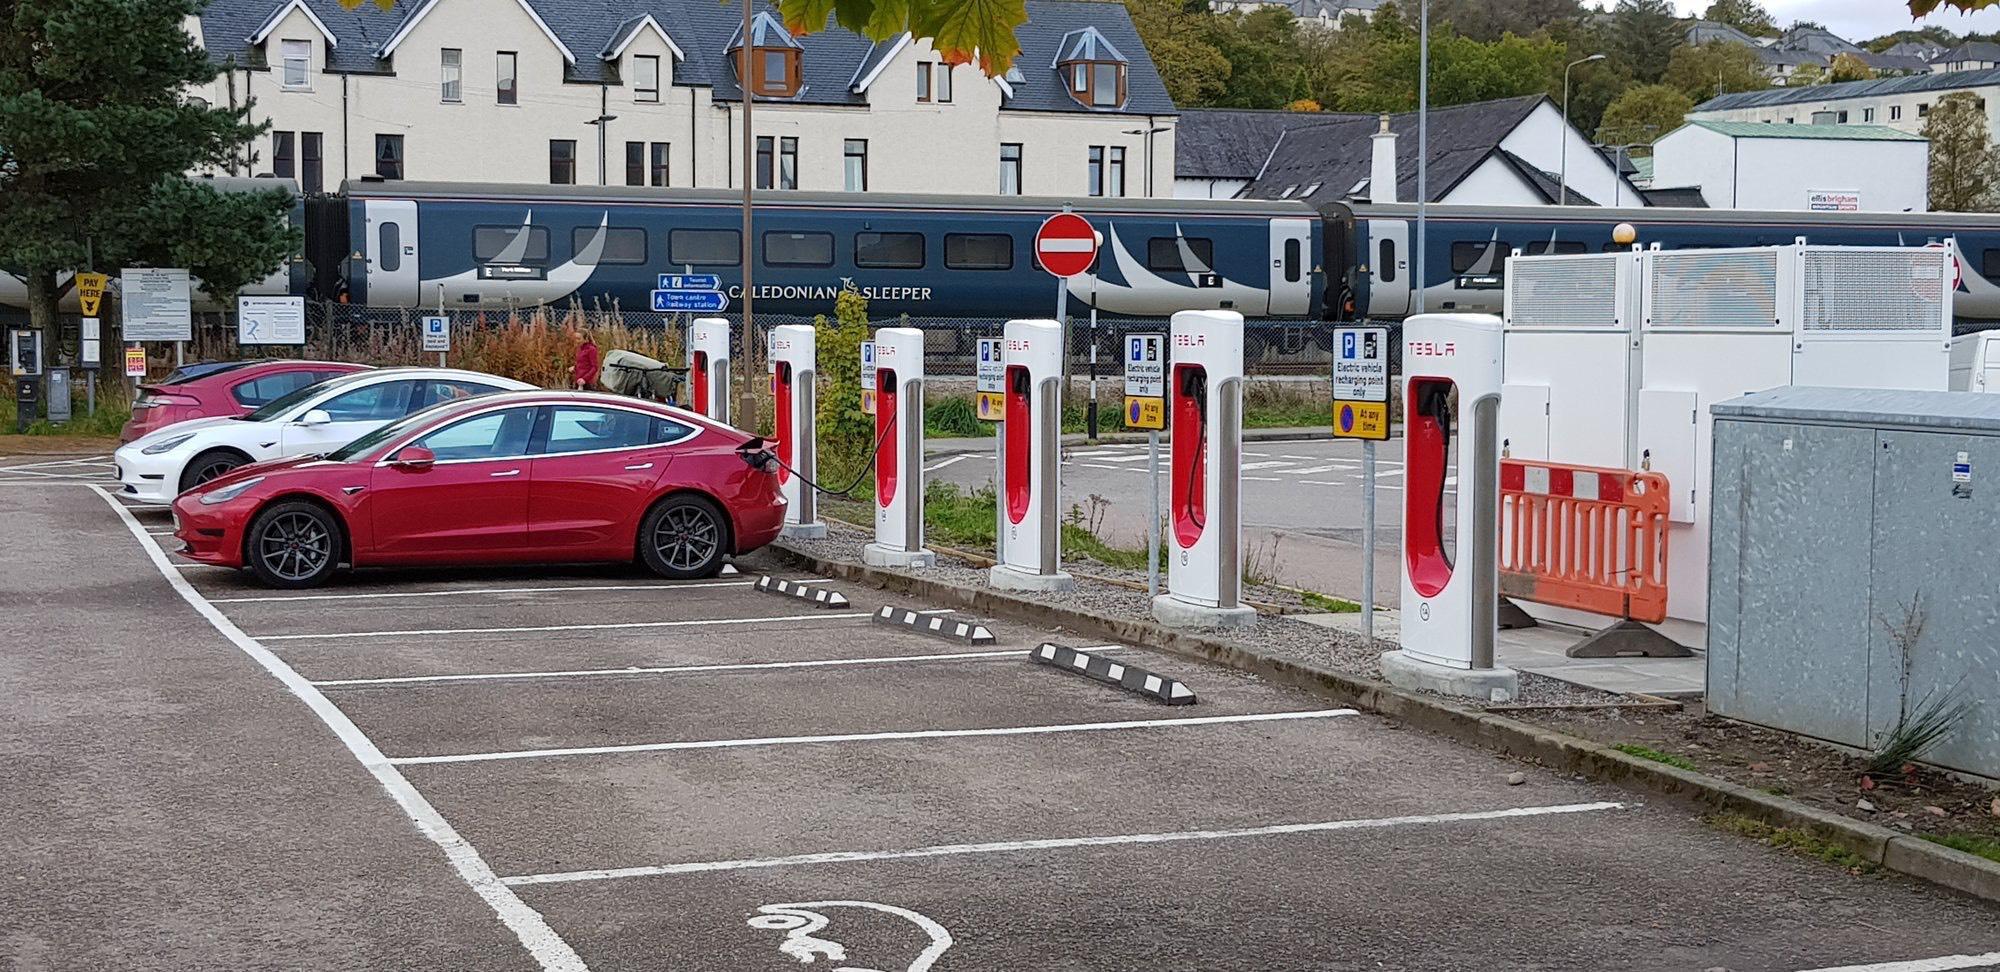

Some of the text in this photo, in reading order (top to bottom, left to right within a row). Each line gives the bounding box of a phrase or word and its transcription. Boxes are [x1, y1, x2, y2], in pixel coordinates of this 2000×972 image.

[83, 278, 99, 287] PAY
[80, 289, 100, 297] HERE
[862, 287, 931, 300] SLEEPER
[1174, 334, 1205, 346] TESLA
[1409, 342, 1454, 356] TESLA
[1128, 363, 1144, 373] Electric
[1337, 362, 1382, 373] Electric vehicle
[1335, 375, 1384, 386] recharging point
[1353, 387, 1366, 398] only
[1360, 409, 1379, 421] At any
[1363, 421, 1376, 431] time
